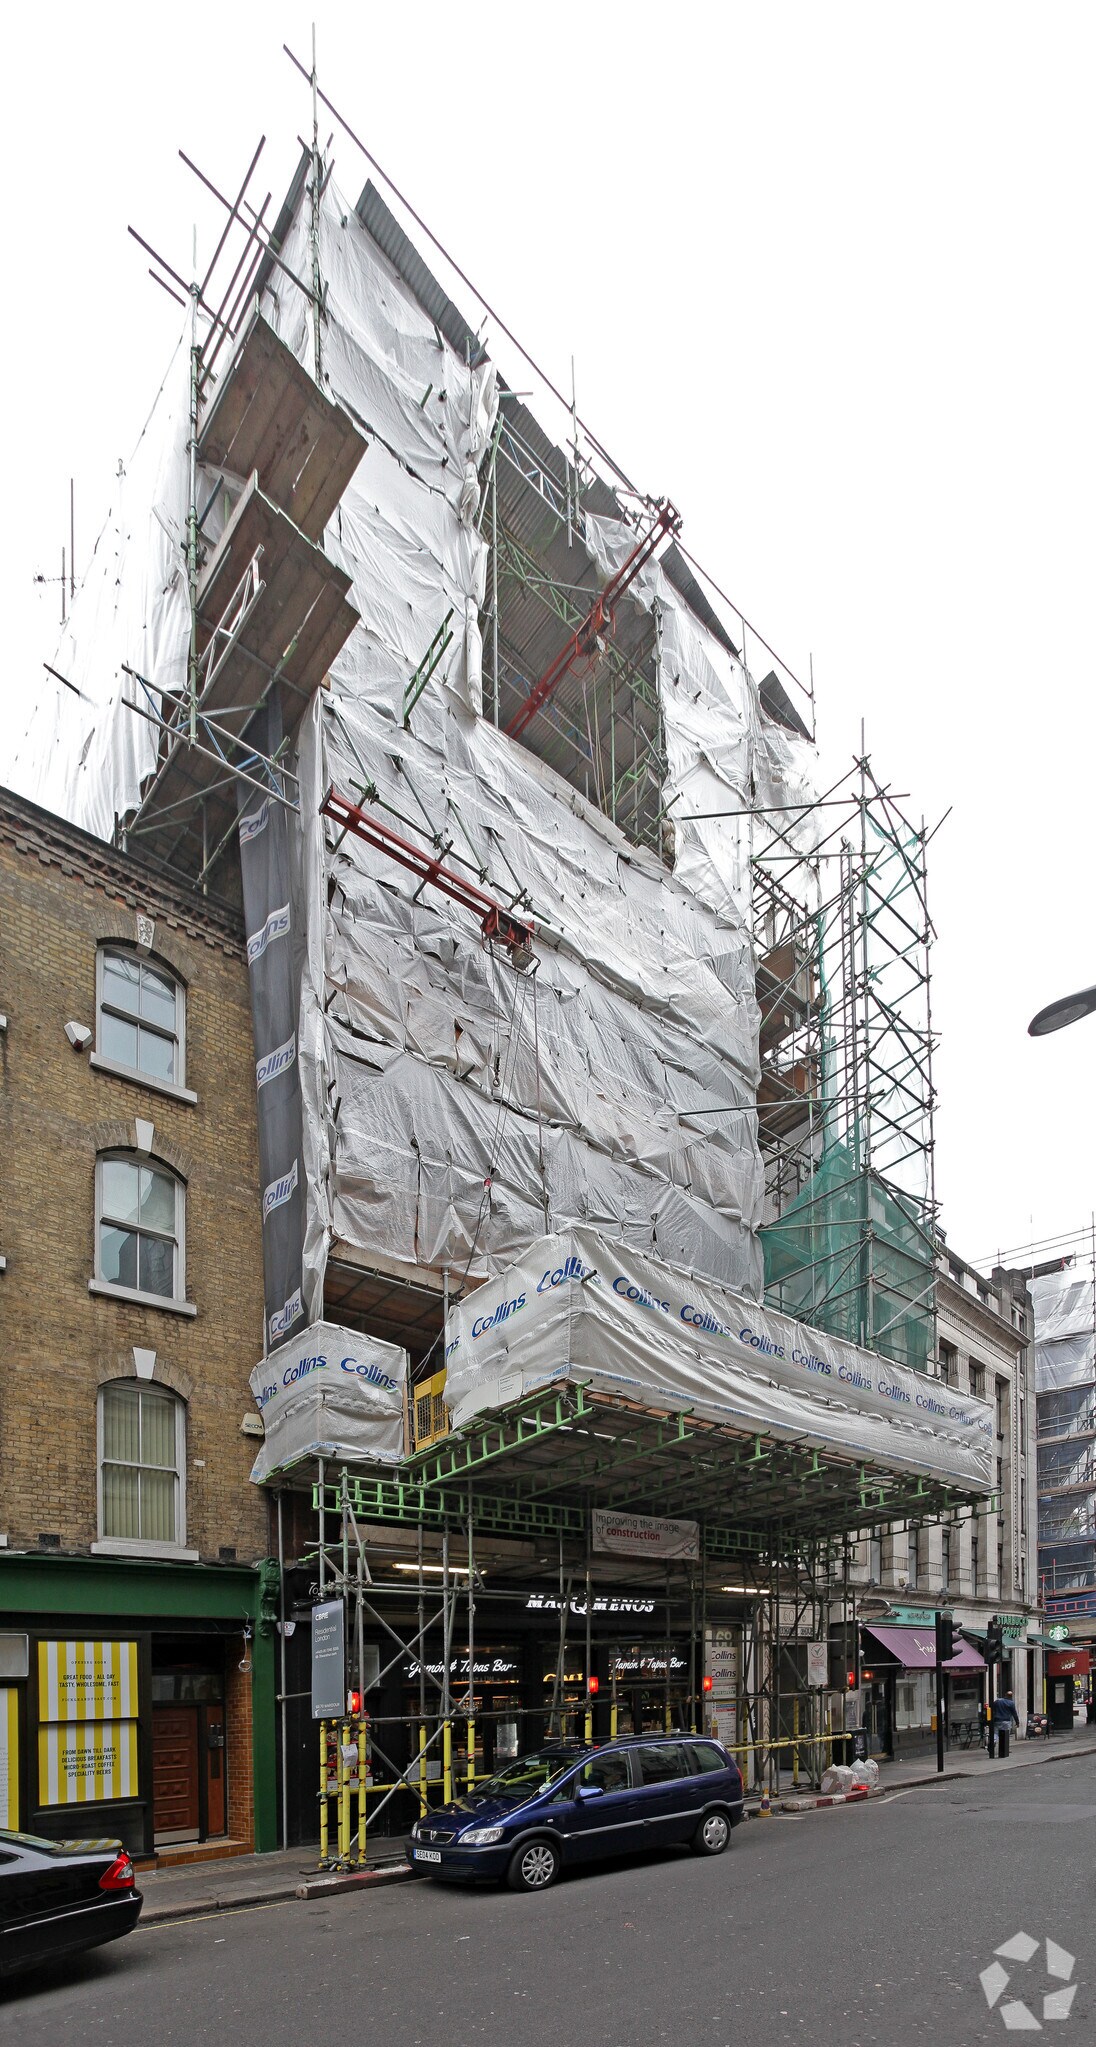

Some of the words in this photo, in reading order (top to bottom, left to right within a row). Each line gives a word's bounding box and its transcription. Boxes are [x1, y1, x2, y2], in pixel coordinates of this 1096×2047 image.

[472, 1292, 526, 1338] Collins
[612, 1276, 670, 1313] Collins
[680, 1304, 730, 1335] Collins
[739, 1328, 784, 1358] Collins
[792, 1349, 832, 1375] Collins
[838, 1366, 872, 1390] Collins
[878, 1381, 910, 1403] Collins
[916, 1394, 945, 1415] Collins
[950, 1406, 974, 1426] Collins
[283, 1355, 327, 1386] Collins
[340, 1358, 398, 1390] Collins
[595, 1512, 637, 1530] Improving
[640, 1519, 653, 1529] the
[655, 1520, 679, 1534] image
[596, 1524, 605, 1534] of
[606, 1527, 660, 1541] construction
[591, 1598, 655, 1612] MENOS
[997, 1615, 1029, 1626] STARBUCKS
[711, 1651, 736, 1660] Collins
[711, 1669, 736, 1678] Collins
